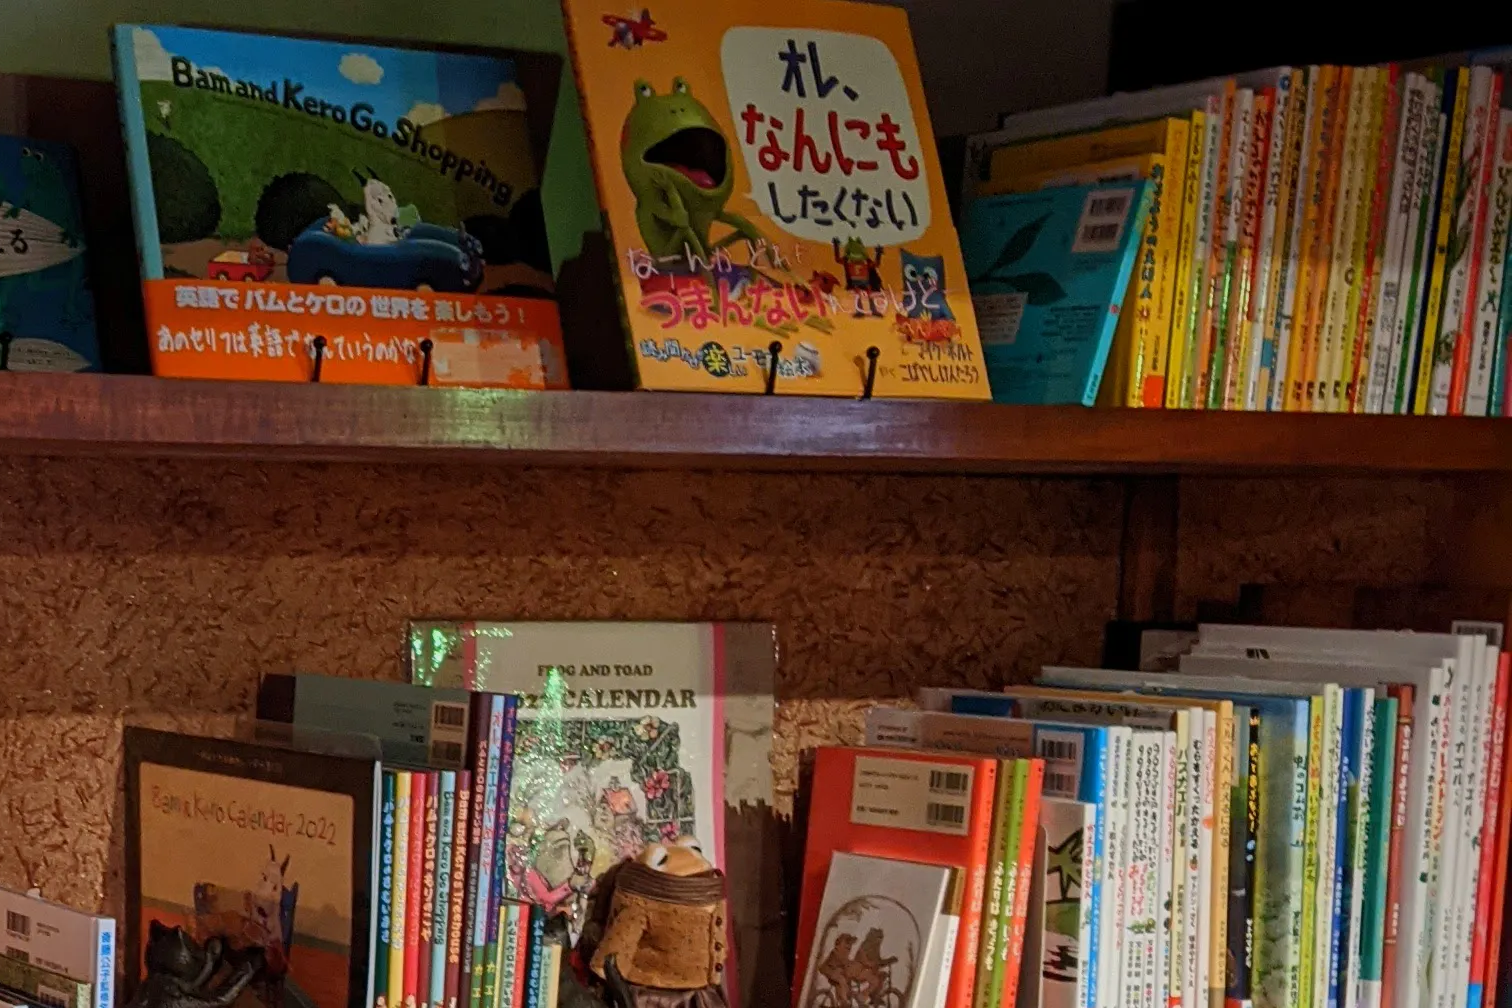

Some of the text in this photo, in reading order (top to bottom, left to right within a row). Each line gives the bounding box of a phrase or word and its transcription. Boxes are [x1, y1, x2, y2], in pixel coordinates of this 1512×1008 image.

[778, 39, 859, 100] オレ、
[170, 55, 516, 207] Bam and Kero Go Shopping
[741, 103, 920, 181] なんにも
[767, 181, 919, 231] したくない
[640, 279, 829, 331] つまんない
[579, 664, 611, 677] AND
[614, 664, 653, 677] TOAD
[563, 688, 697, 709] CALENDAR
[295, 812, 337, 846] 2022
